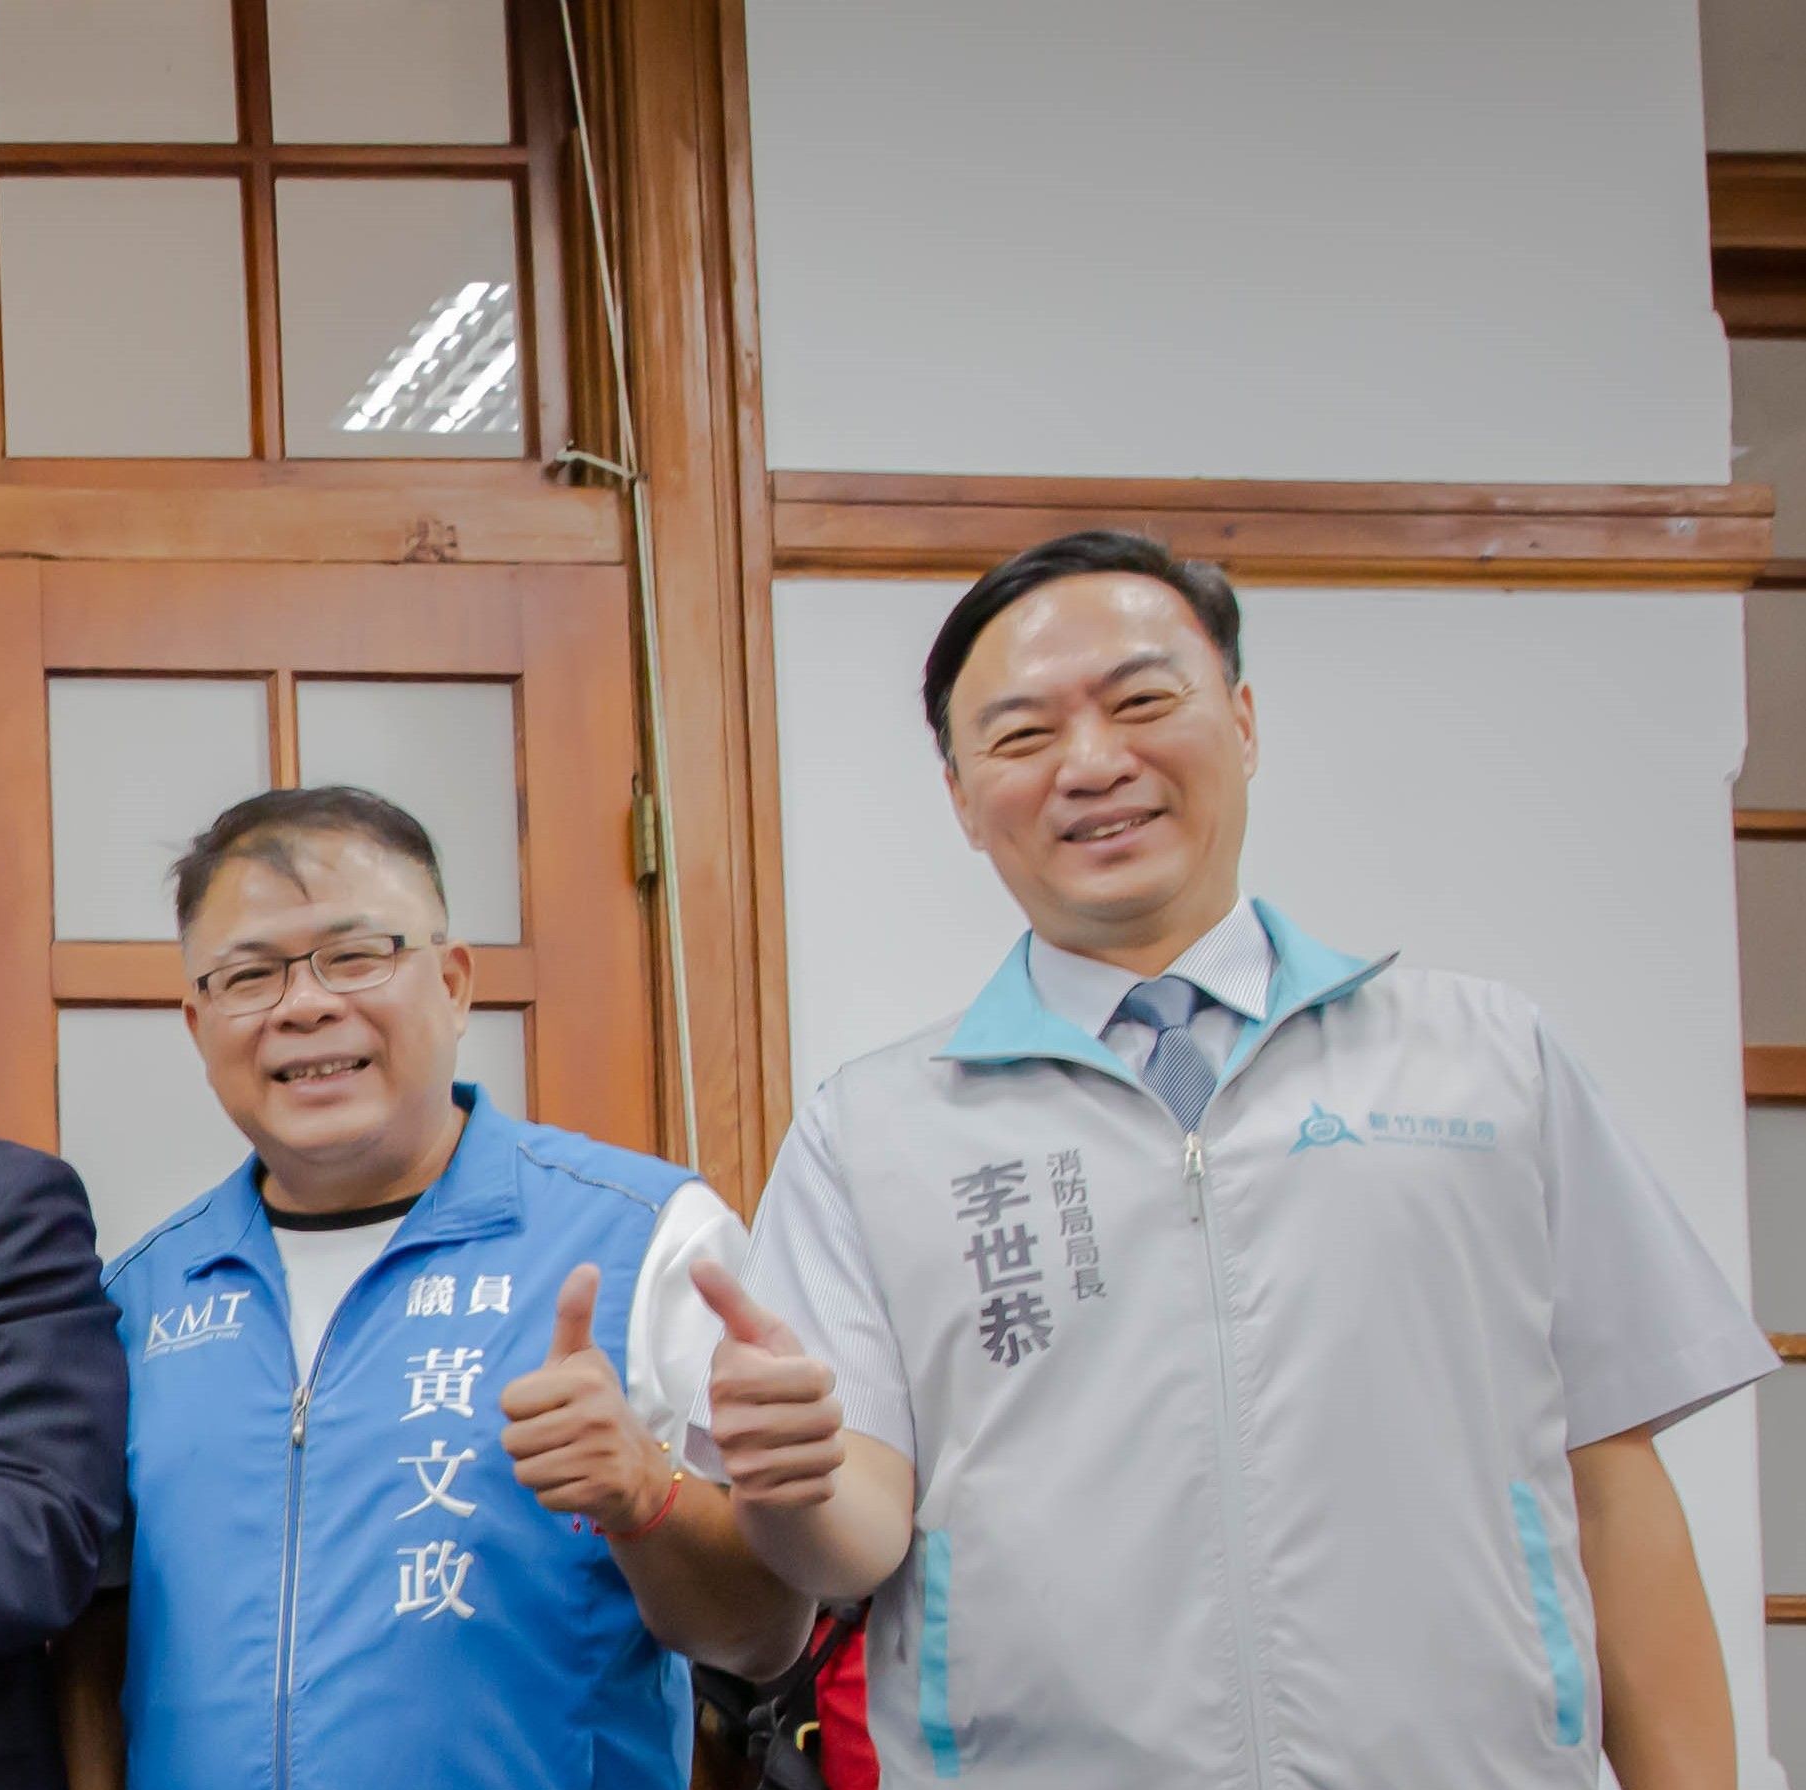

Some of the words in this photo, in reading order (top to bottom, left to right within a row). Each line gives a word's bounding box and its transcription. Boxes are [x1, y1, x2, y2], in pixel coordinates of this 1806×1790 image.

[406, 1274, 512, 1317] 議員
[950, 1159, 1054, 1367] 李世恭
[1045, 1148, 1107, 1301] 消防局局長
[145, 1289, 251, 1348] KMT
[394, 1347, 485, 1622] 黃文政
